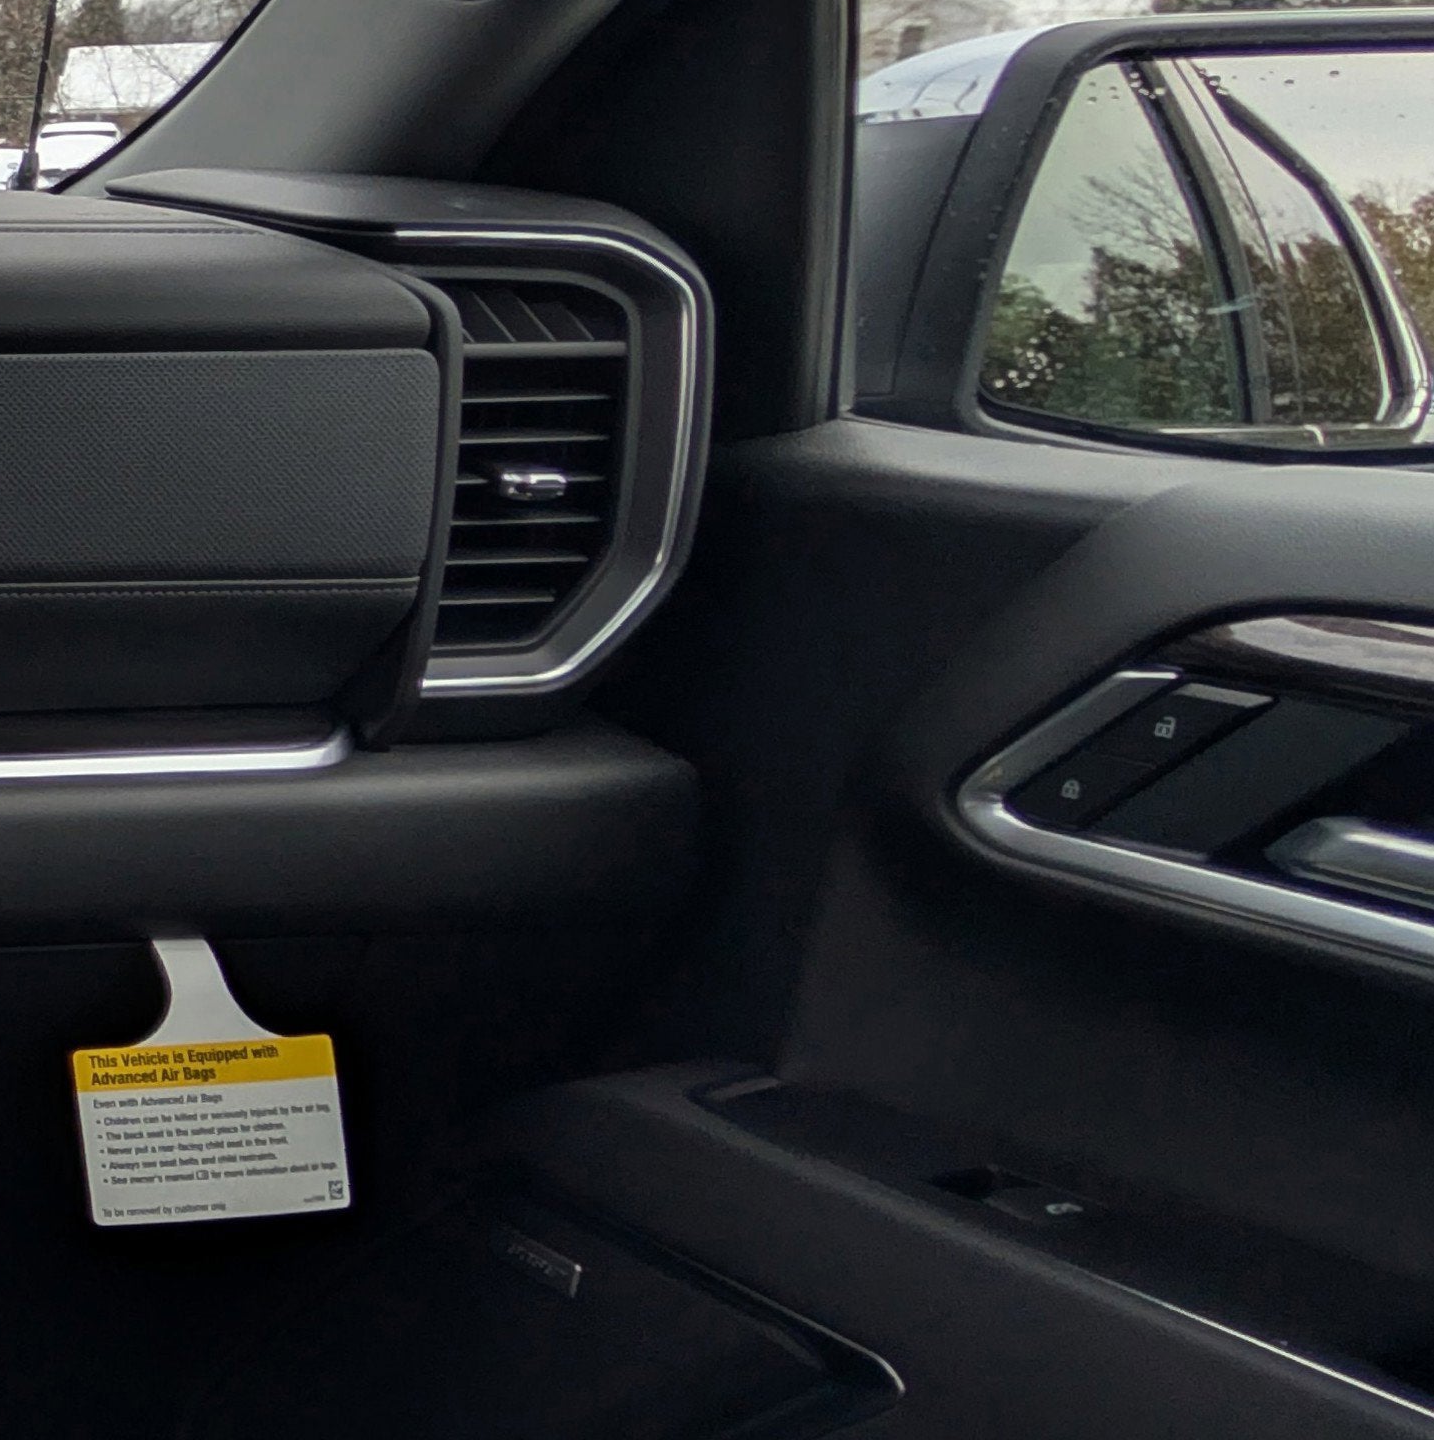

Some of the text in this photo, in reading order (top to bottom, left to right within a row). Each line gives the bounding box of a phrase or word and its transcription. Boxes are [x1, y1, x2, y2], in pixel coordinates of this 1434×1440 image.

[88, 1045, 279, 1069] This Vehicle is Equipped with
[91, 1066, 217, 1085] Advanced Air Bags
